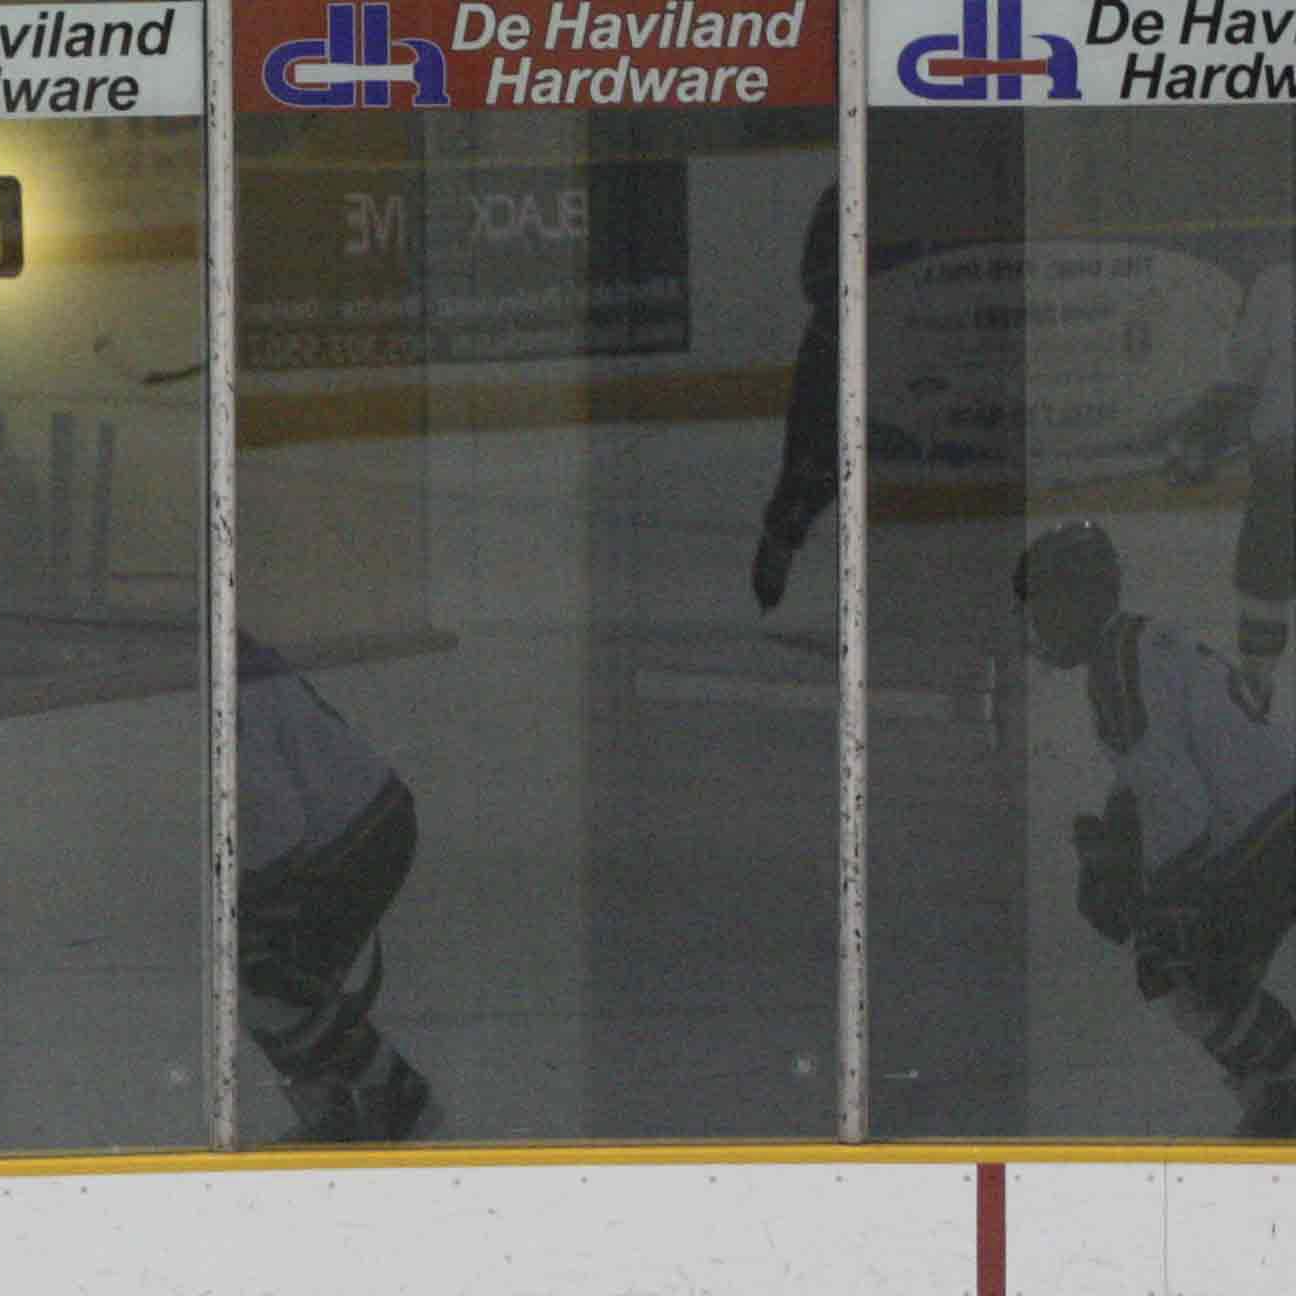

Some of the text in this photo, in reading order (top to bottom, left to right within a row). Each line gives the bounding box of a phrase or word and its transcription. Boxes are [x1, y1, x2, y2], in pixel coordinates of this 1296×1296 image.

[450, 0, 806, 51] De Haviland
[1085, 0, 1165, 46] De
[484, 56, 769, 106] Hardware
